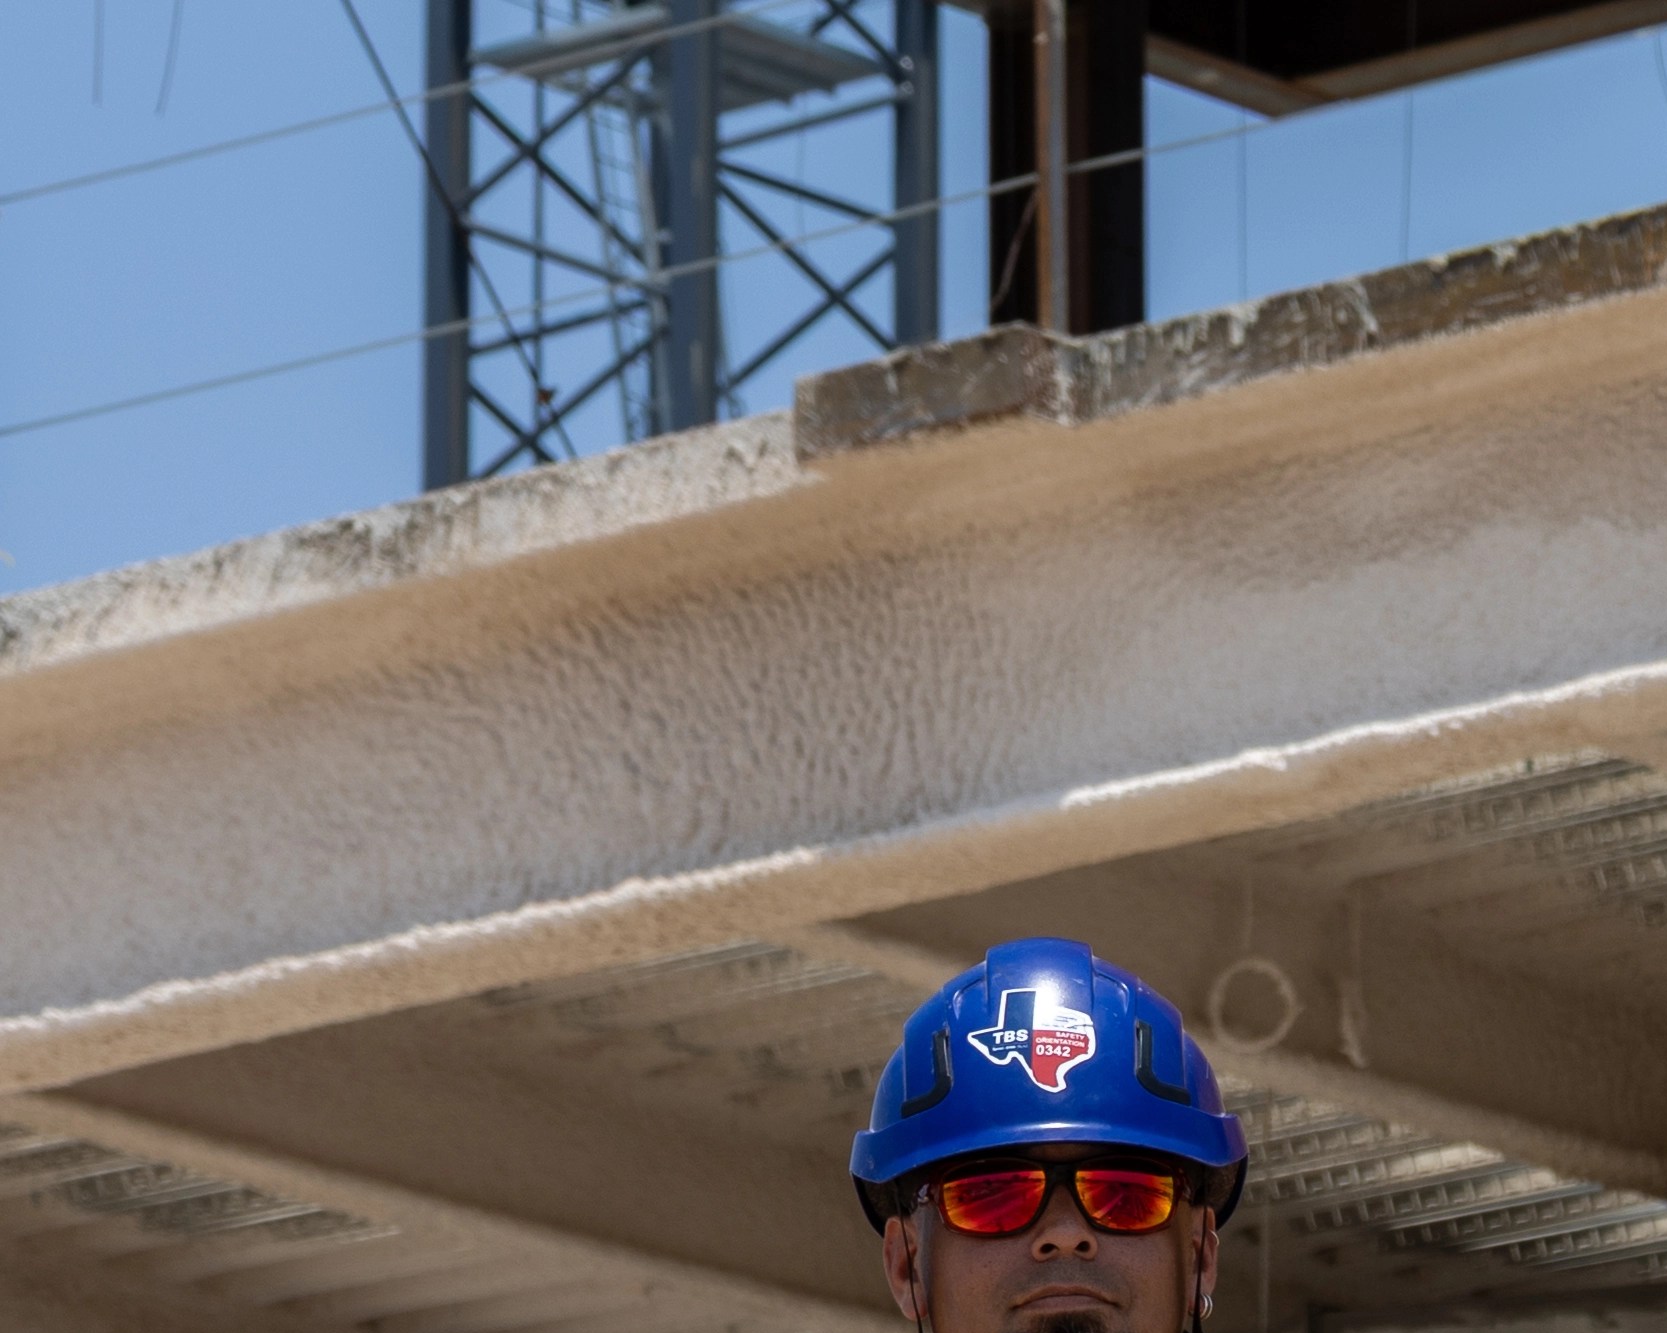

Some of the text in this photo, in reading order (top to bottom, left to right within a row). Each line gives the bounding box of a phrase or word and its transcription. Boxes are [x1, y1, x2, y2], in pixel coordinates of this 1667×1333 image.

[992, 1029, 1028, 1044] TBS
[1056, 1032, 1085, 1040] SAFETY
[1035, 1037, 1085, 1048] ORIENTATION
[1035, 1044, 1071, 1058] 0342
